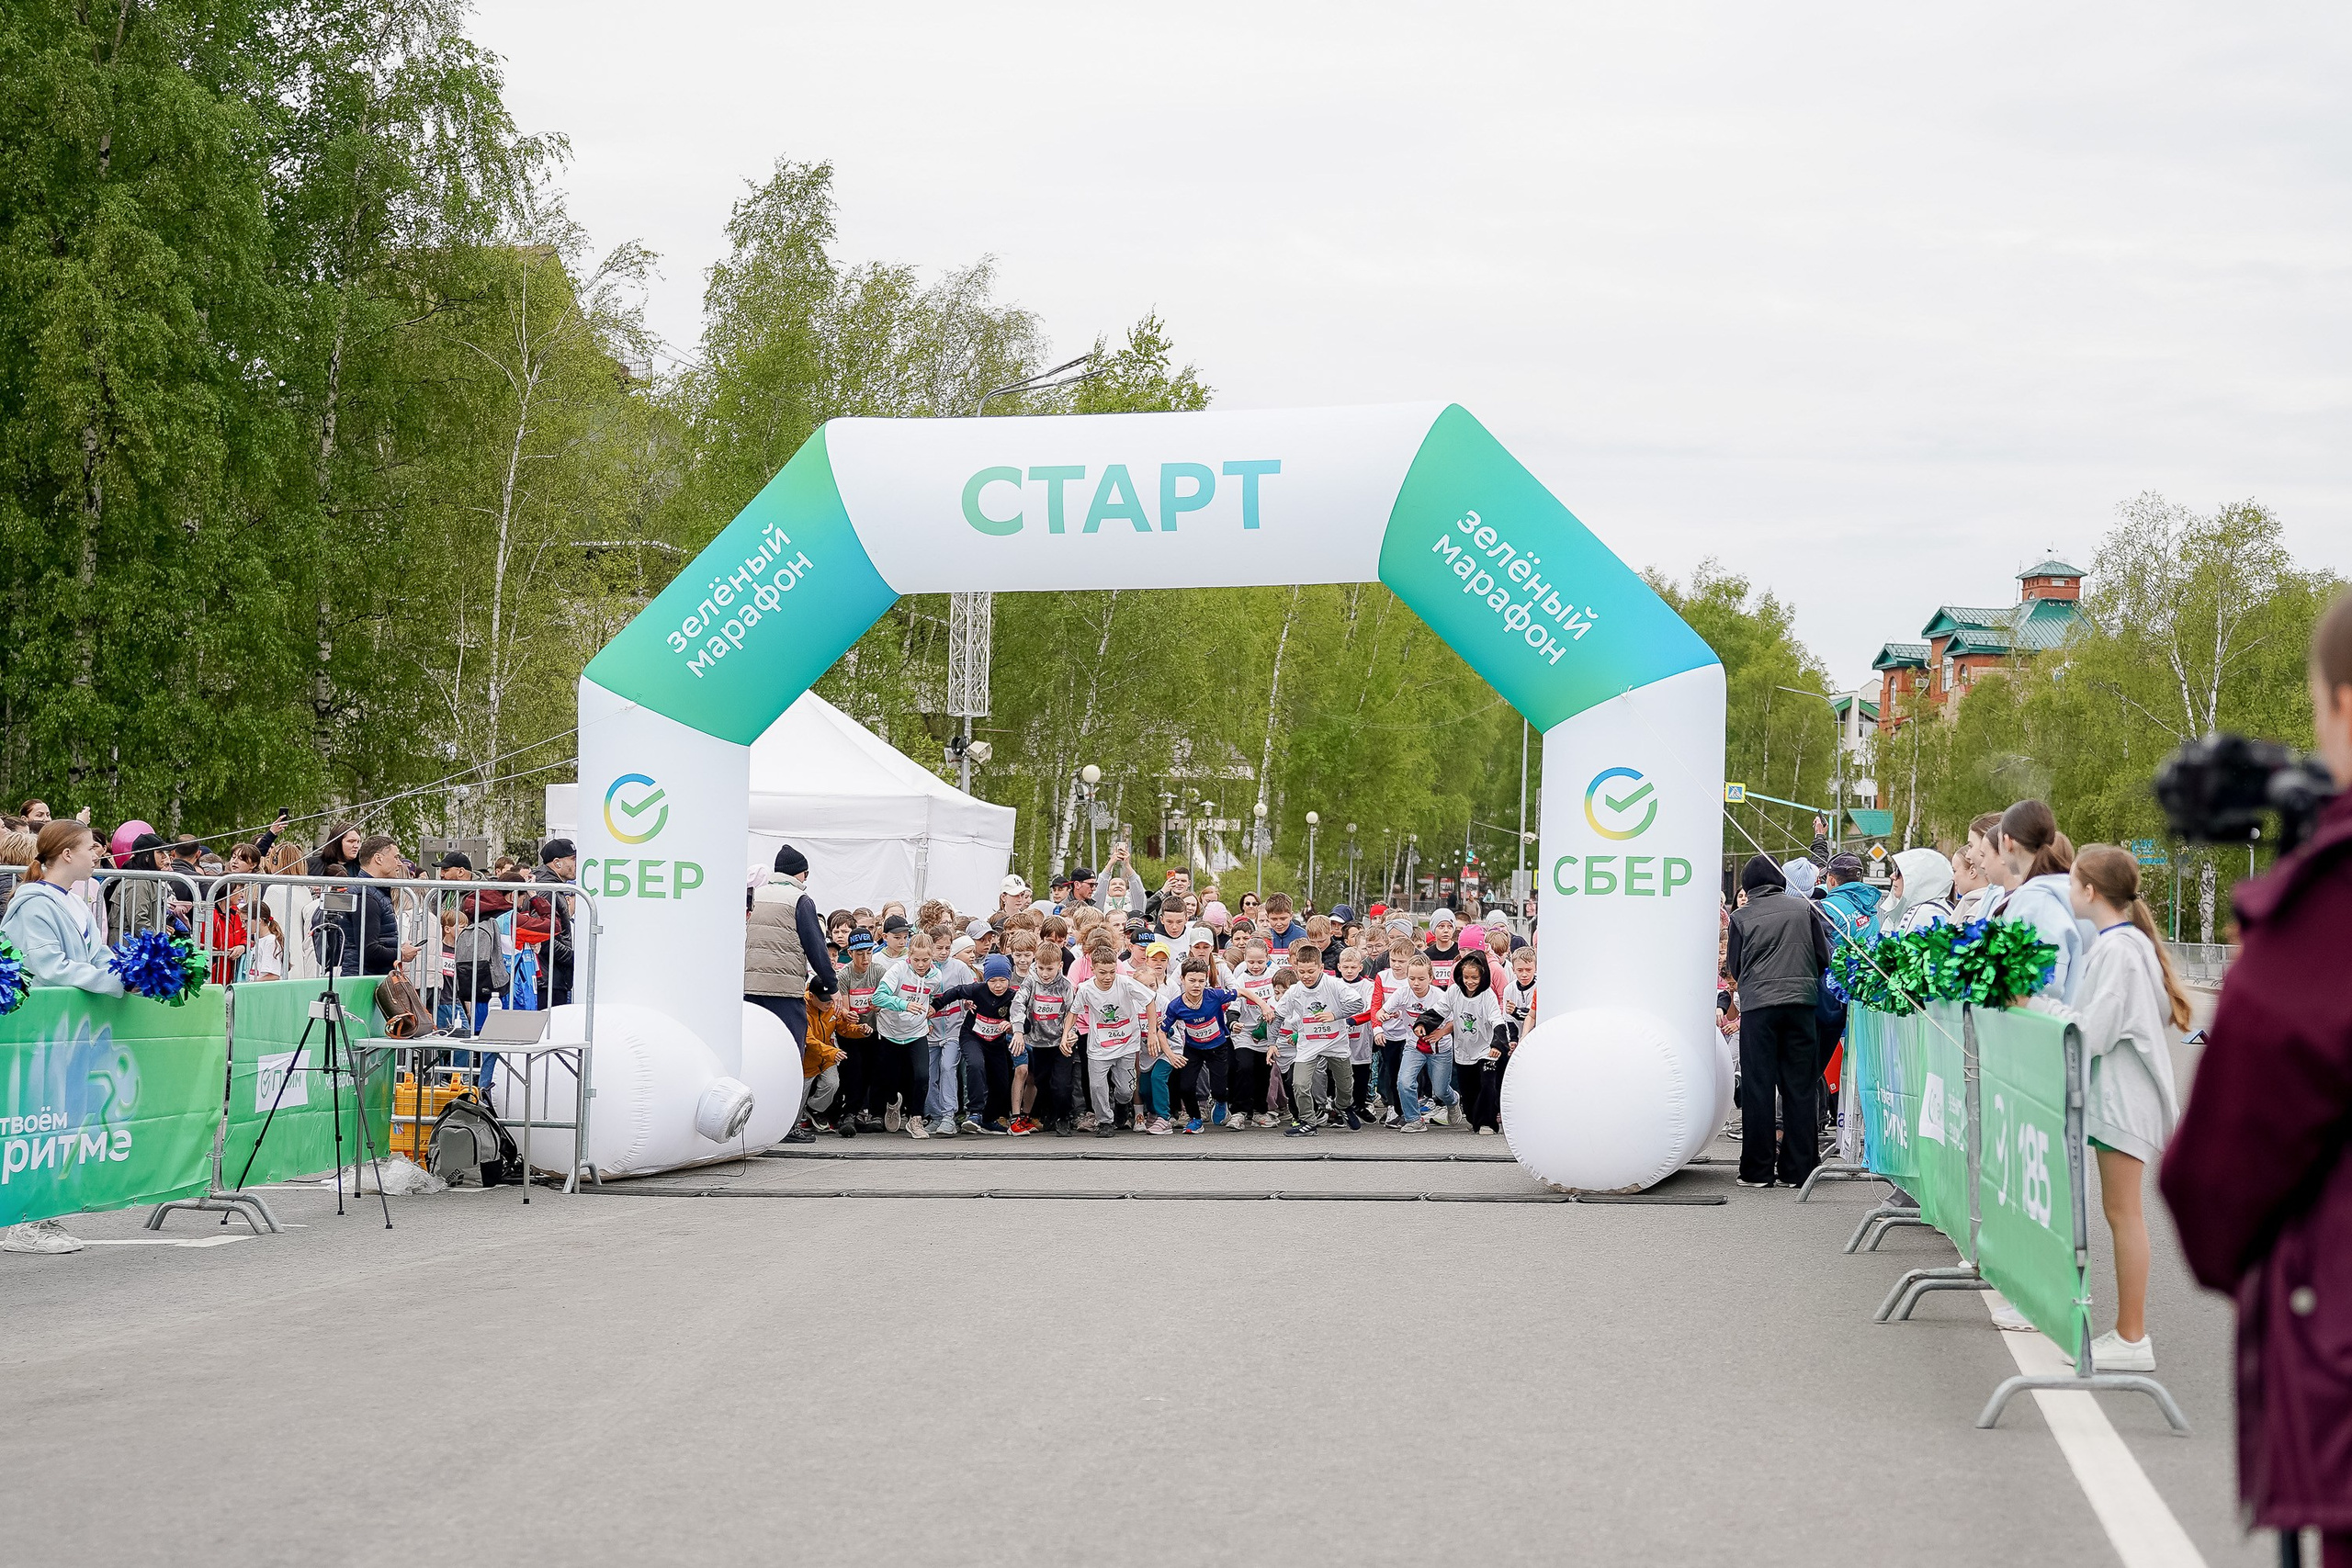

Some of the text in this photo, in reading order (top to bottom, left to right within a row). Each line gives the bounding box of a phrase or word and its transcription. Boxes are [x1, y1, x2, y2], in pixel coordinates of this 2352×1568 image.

[961, 459, 1282, 536] СТАРТ
[666, 522, 792, 654] зелёный
[1431, 534, 1567, 666] марафон
[1456, 509, 1600, 641] зелёный
[685, 550, 814, 679] марафон
[581, 857, 705, 899] СБЕР
[1553, 855, 1692, 897] СБЕР
[850, 933, 871, 943] NEVER
[1195, 1029, 1213, 1038] 2772
[0, 1105, 68, 1136] твоём
[1, 1129, 132, 1185] ритме
